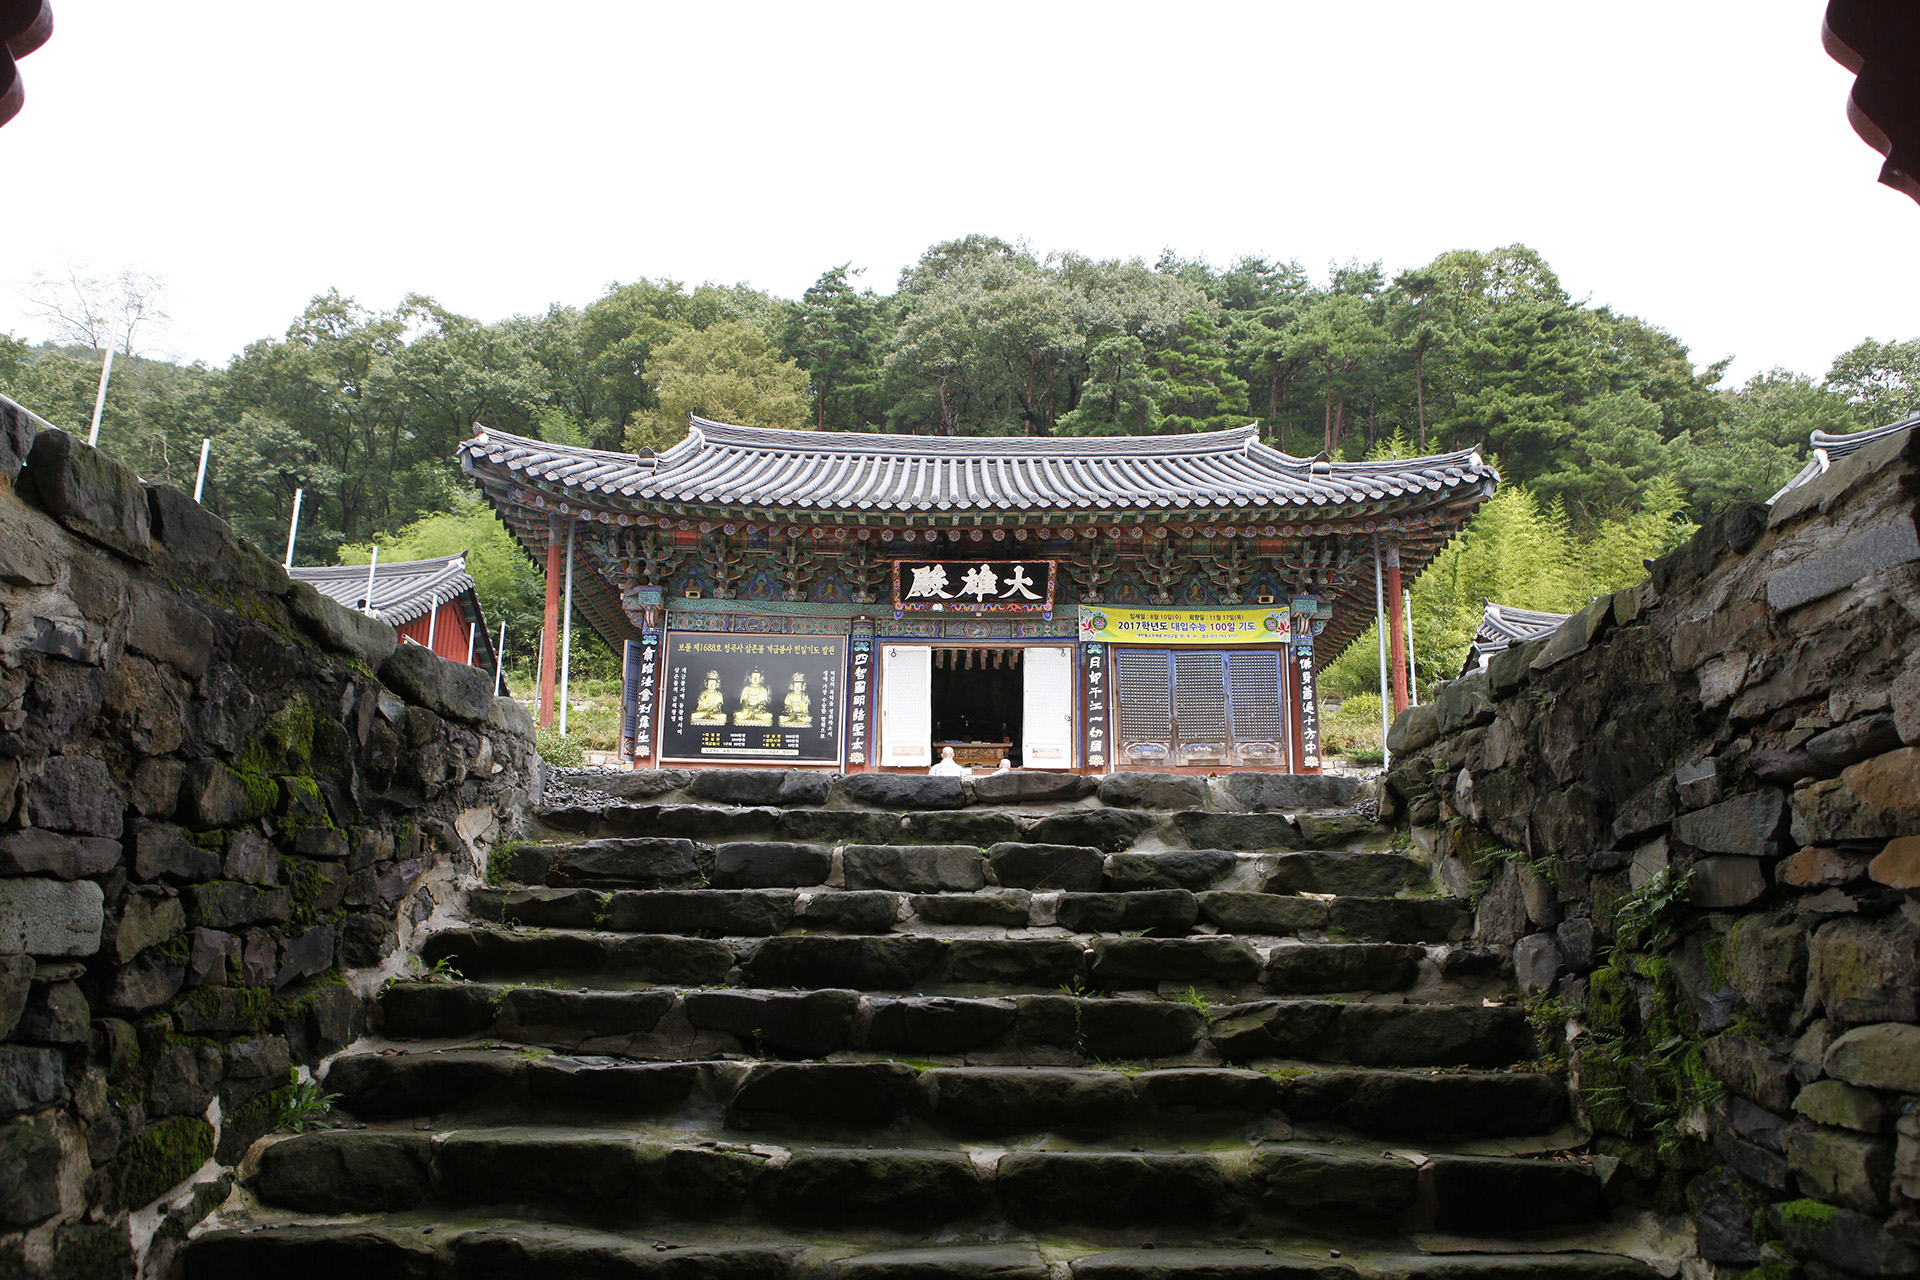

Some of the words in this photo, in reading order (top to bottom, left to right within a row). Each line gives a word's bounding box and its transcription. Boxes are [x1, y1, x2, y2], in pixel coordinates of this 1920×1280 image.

[1118, 621, 1168, 631] 2017학년도
[1171, 622, 1206, 632] 대입수능
[1210, 622, 1235, 632] 100일
[1238, 622, 1256, 631] 기도
[678, 643, 691, 652] 보물
[693, 643, 722, 652] 제1688호
[724, 643, 743, 653] 청곡사
[745, 643, 764, 654] 삼존불
[766, 644, 792, 654] 개금불사
[794, 645, 820, 654] 천일기도
[822, 645, 834, 655] 발원
